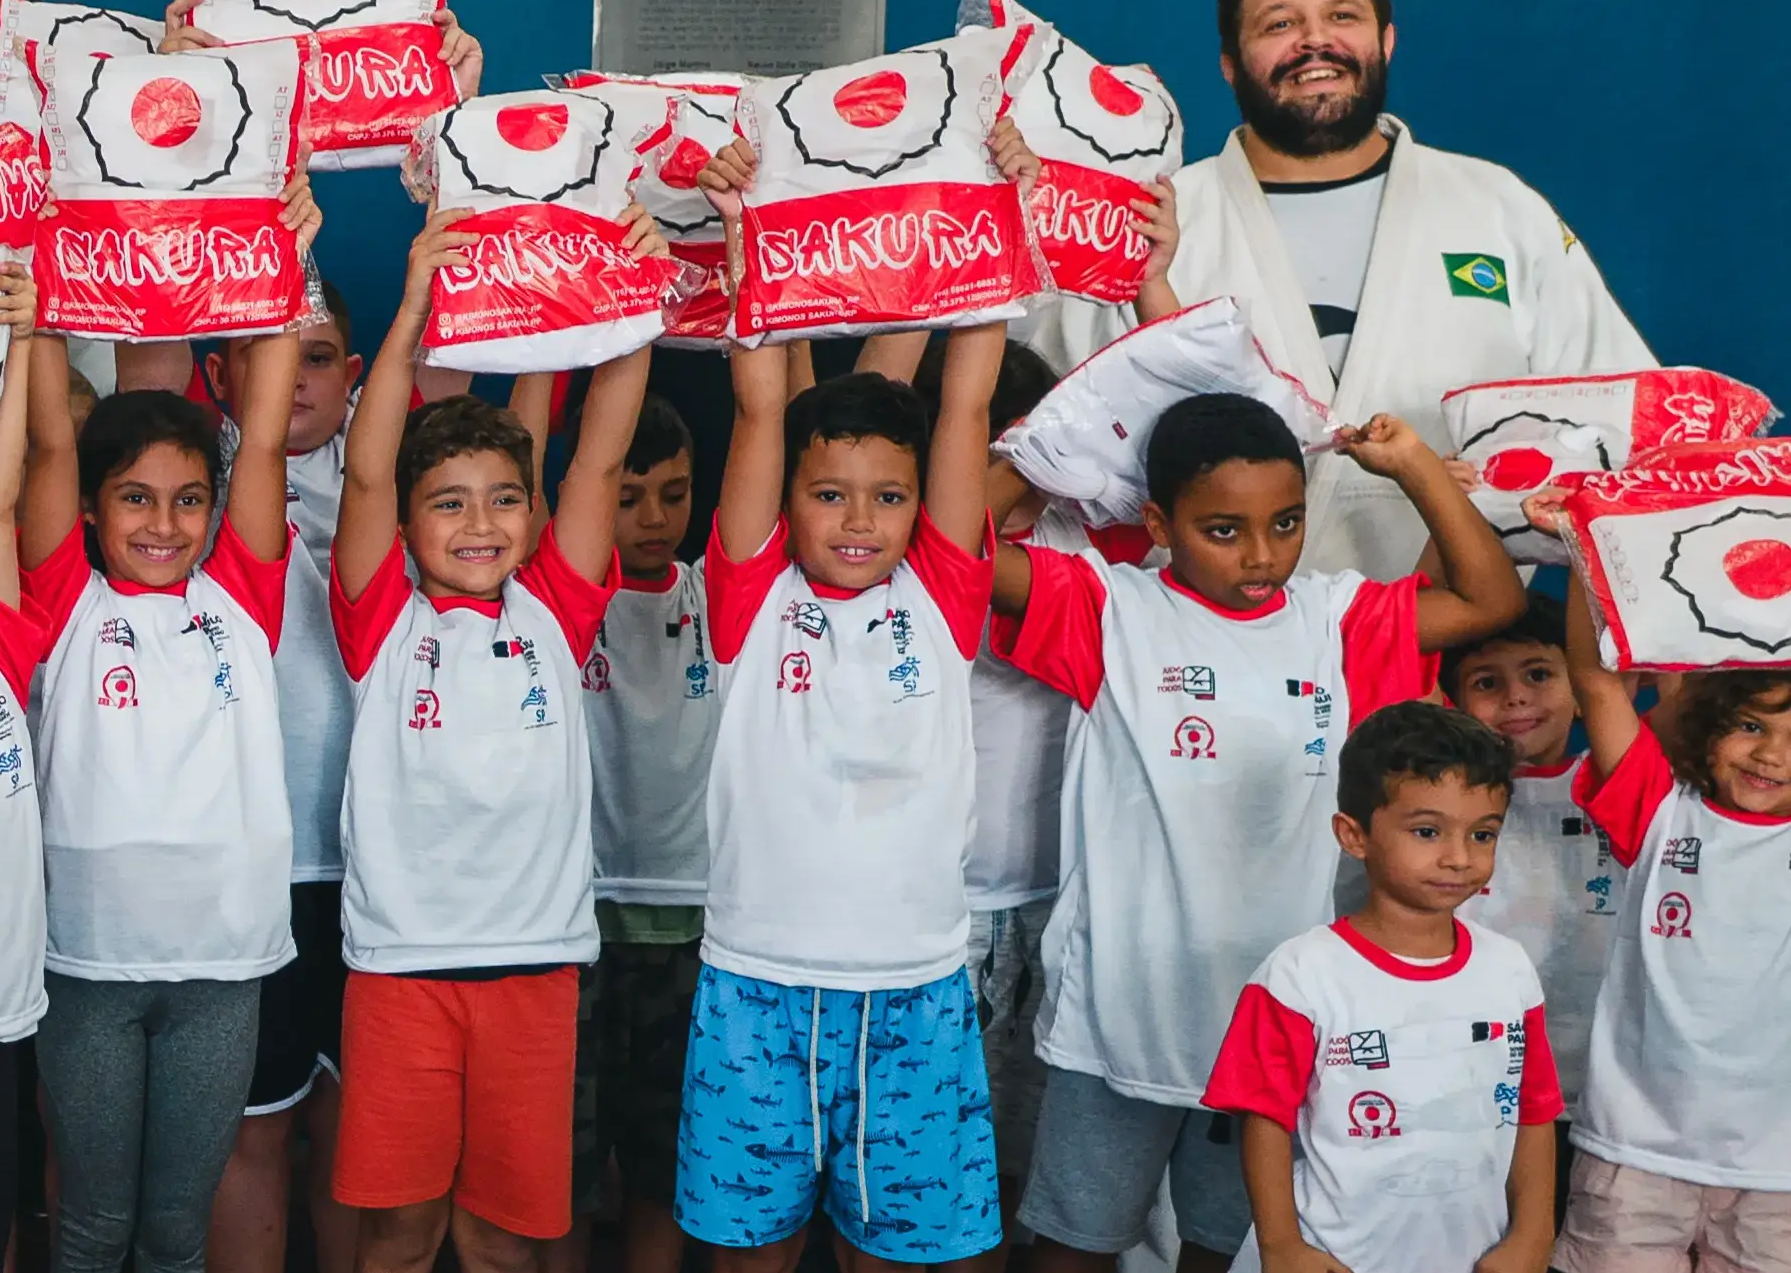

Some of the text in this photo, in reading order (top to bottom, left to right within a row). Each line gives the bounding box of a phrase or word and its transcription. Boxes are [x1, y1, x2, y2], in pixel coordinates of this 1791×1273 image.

[310, 45, 433, 103] URA
[56, 225, 282, 287] SAKURA
[757, 209, 1002, 284] SAKURA
[765, 313, 806, 325] KIMONOS
[1328, 1047, 1349, 1055] PARA
